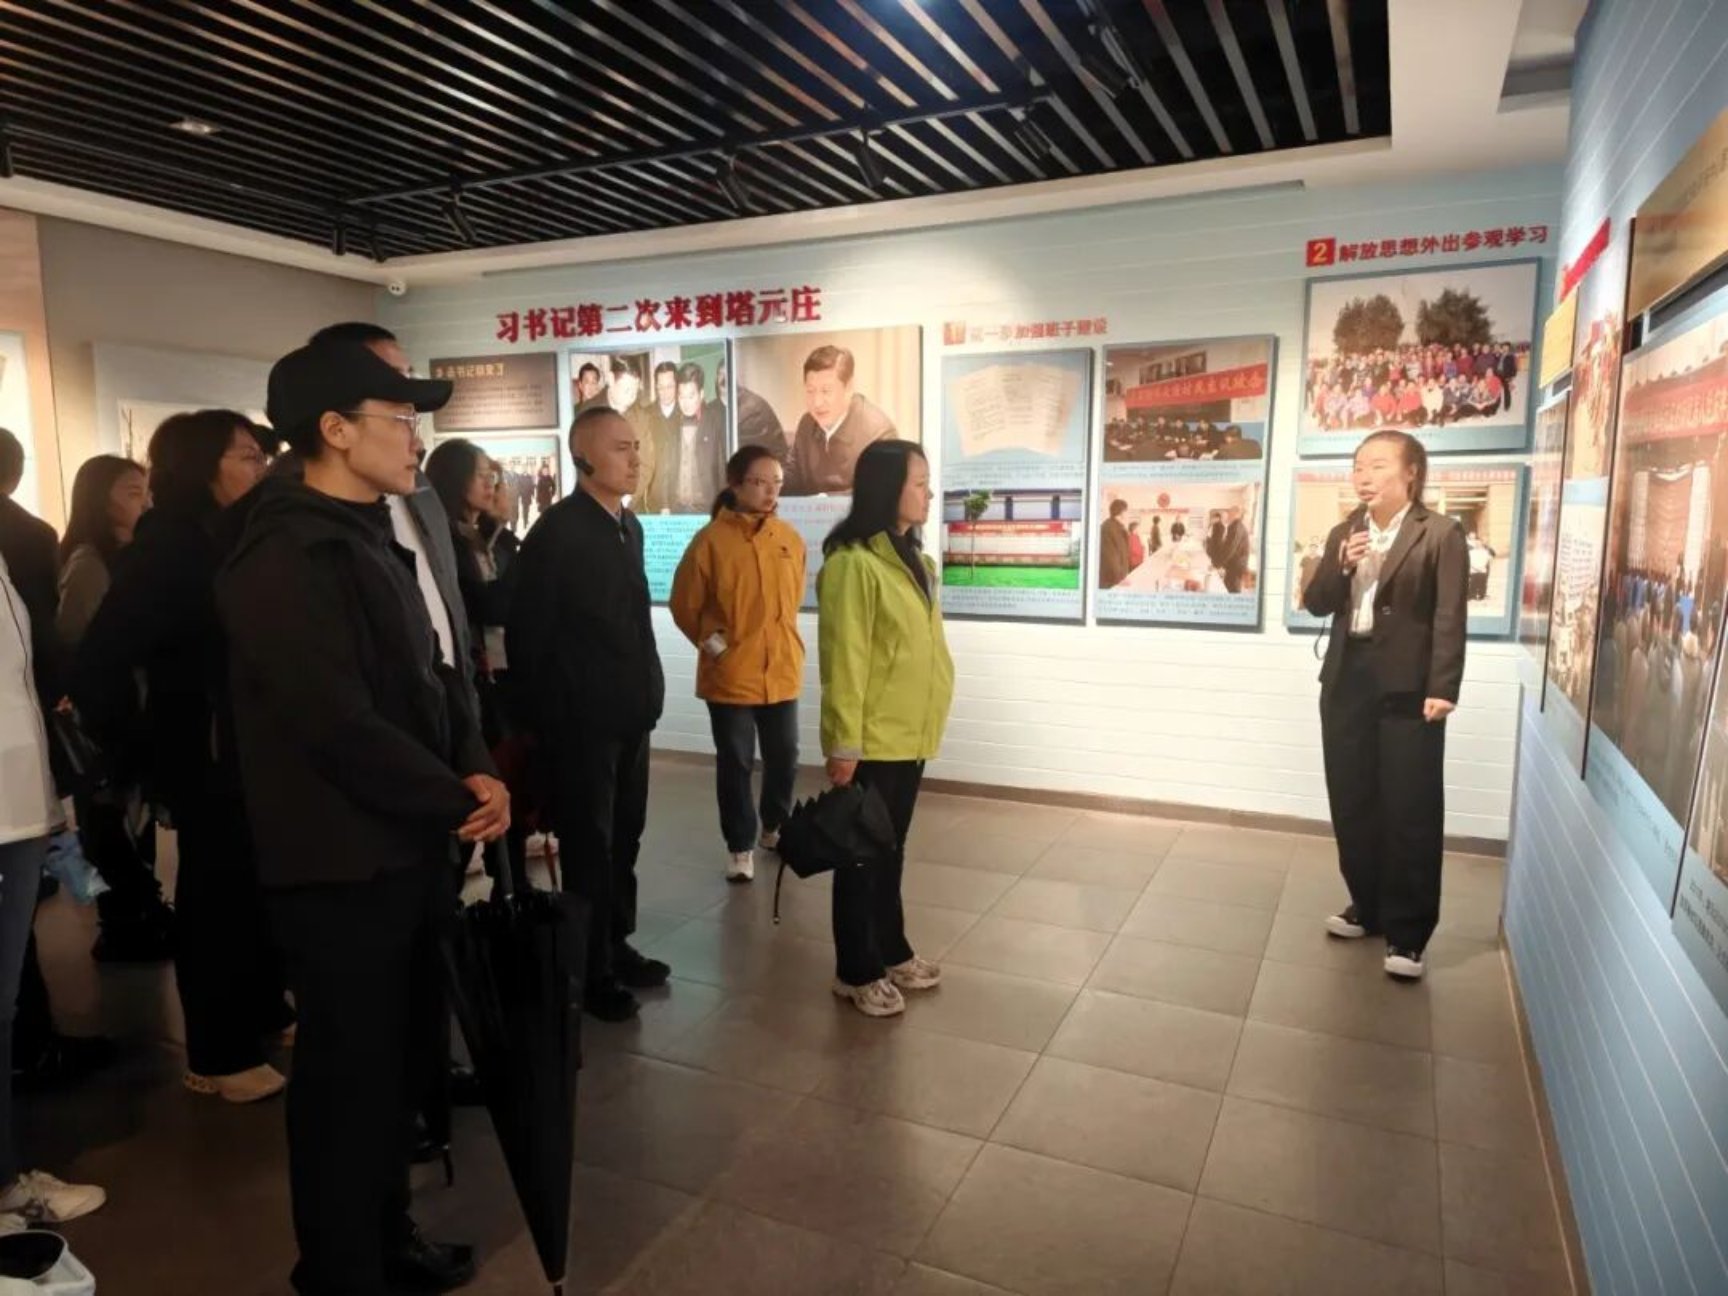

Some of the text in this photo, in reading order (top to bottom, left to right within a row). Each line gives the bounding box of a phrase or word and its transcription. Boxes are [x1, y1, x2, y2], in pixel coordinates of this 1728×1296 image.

[1339, 226, 1548, 262] 解放思想外出参观学习
[496, 286, 821, 342] 习书记第二次来到塔元庄
